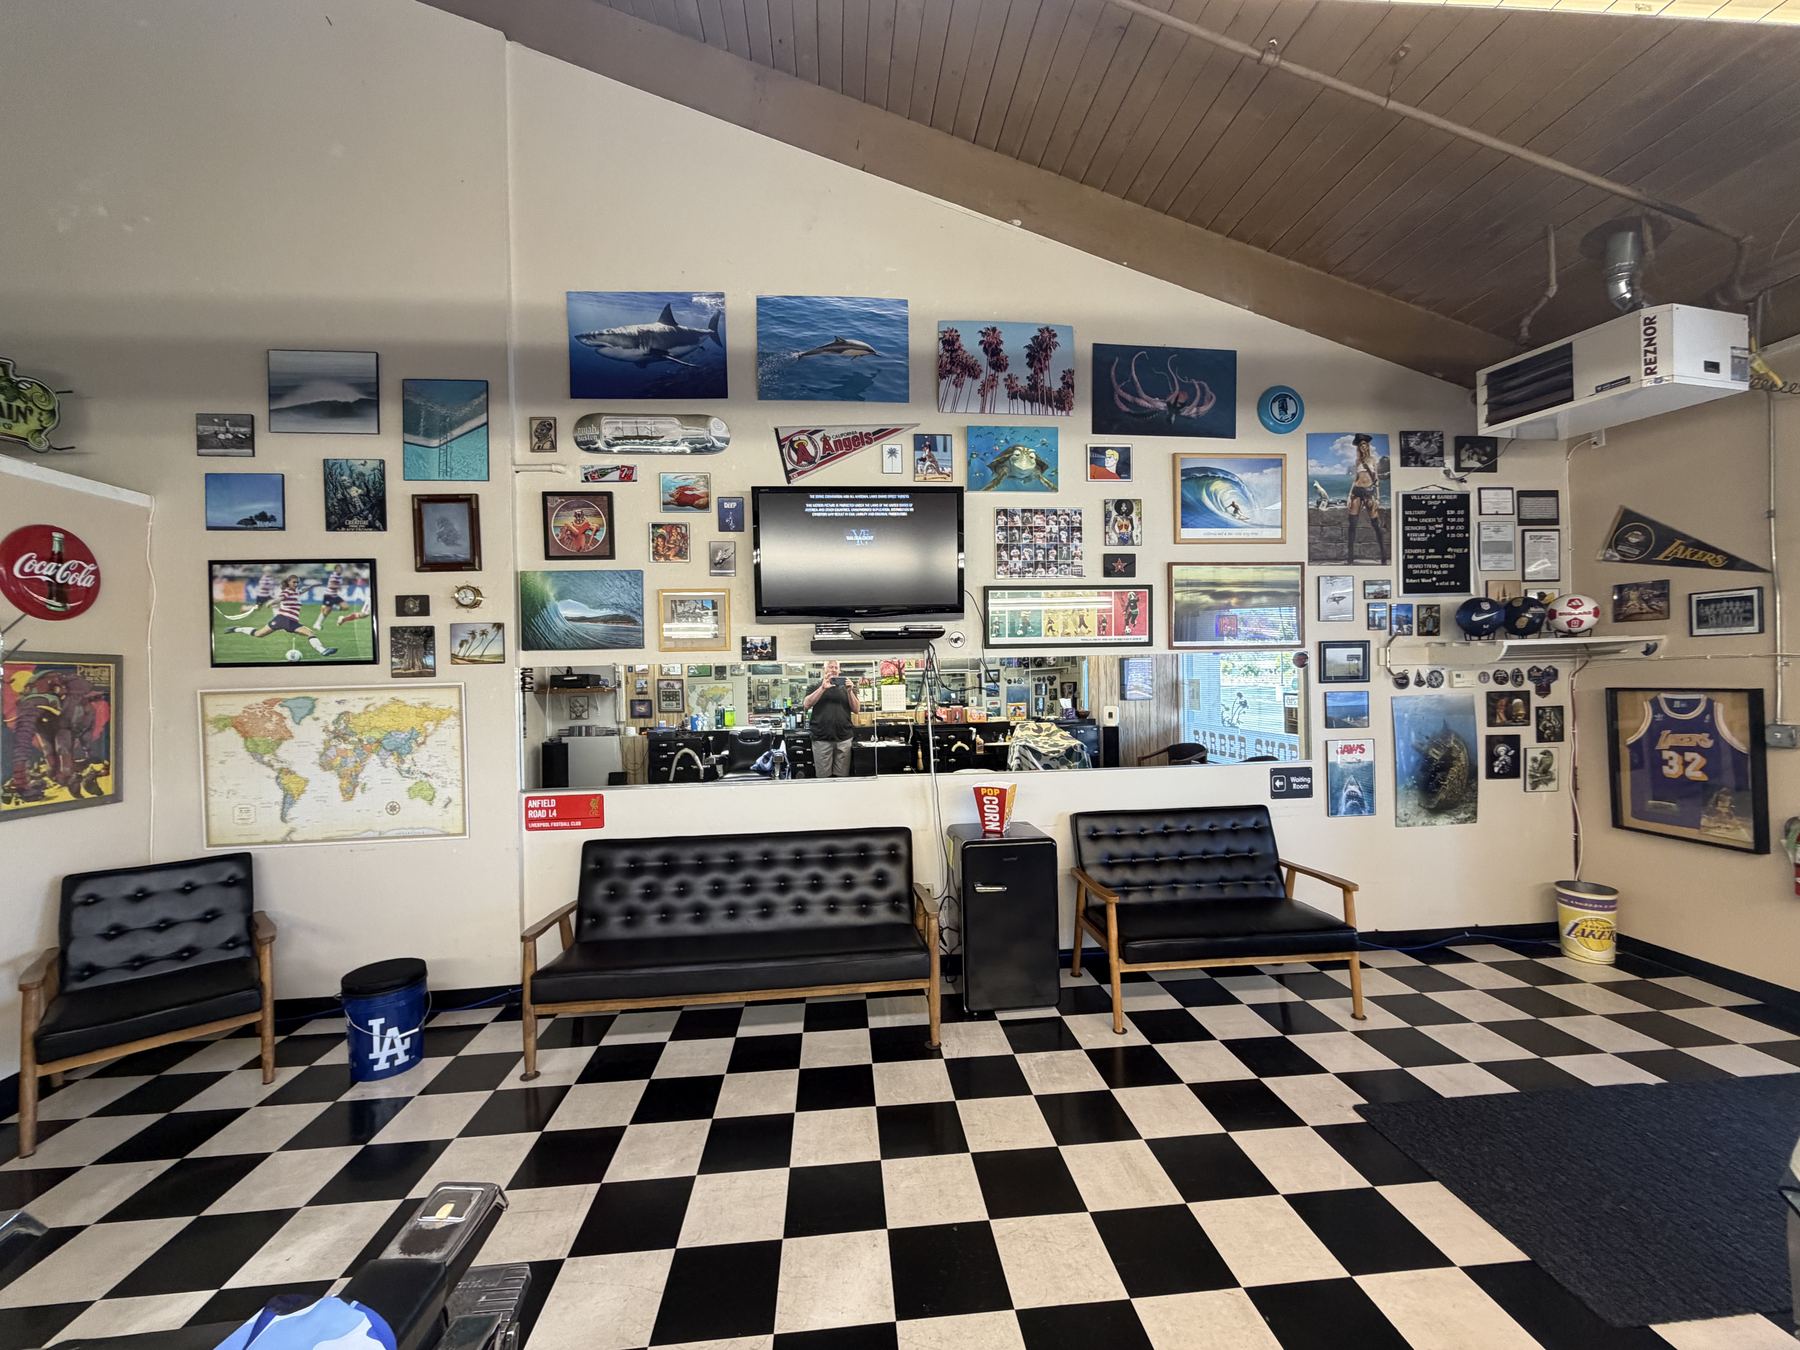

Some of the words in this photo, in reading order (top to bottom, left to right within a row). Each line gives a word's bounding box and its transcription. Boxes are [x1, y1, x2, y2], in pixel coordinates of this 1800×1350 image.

[1643, 314, 1658, 377] REZNOR
[821, 432, 874, 455] Angels
[832, 430, 858, 439] CALIFORNIA
[1653, 538, 1729, 567] LAKERS
[13, 552, 98, 588] Coca-Cola
[1193, 730, 1248, 760] BARBER
[1254, 738, 1299, 761] SHOP
[1336, 744, 1366, 755] JAWS
[1661, 750, 1709, 781] 32
[980, 787, 1000, 796] POP
[1290, 776, 1311, 784] Waiting
[527, 798, 556, 808] ANFIELD
[528, 809, 547, 818] ROAD
[548, 809, 557, 818] L4
[983, 796, 1001, 831] CORN
[368, 1017, 411, 1072] LA
